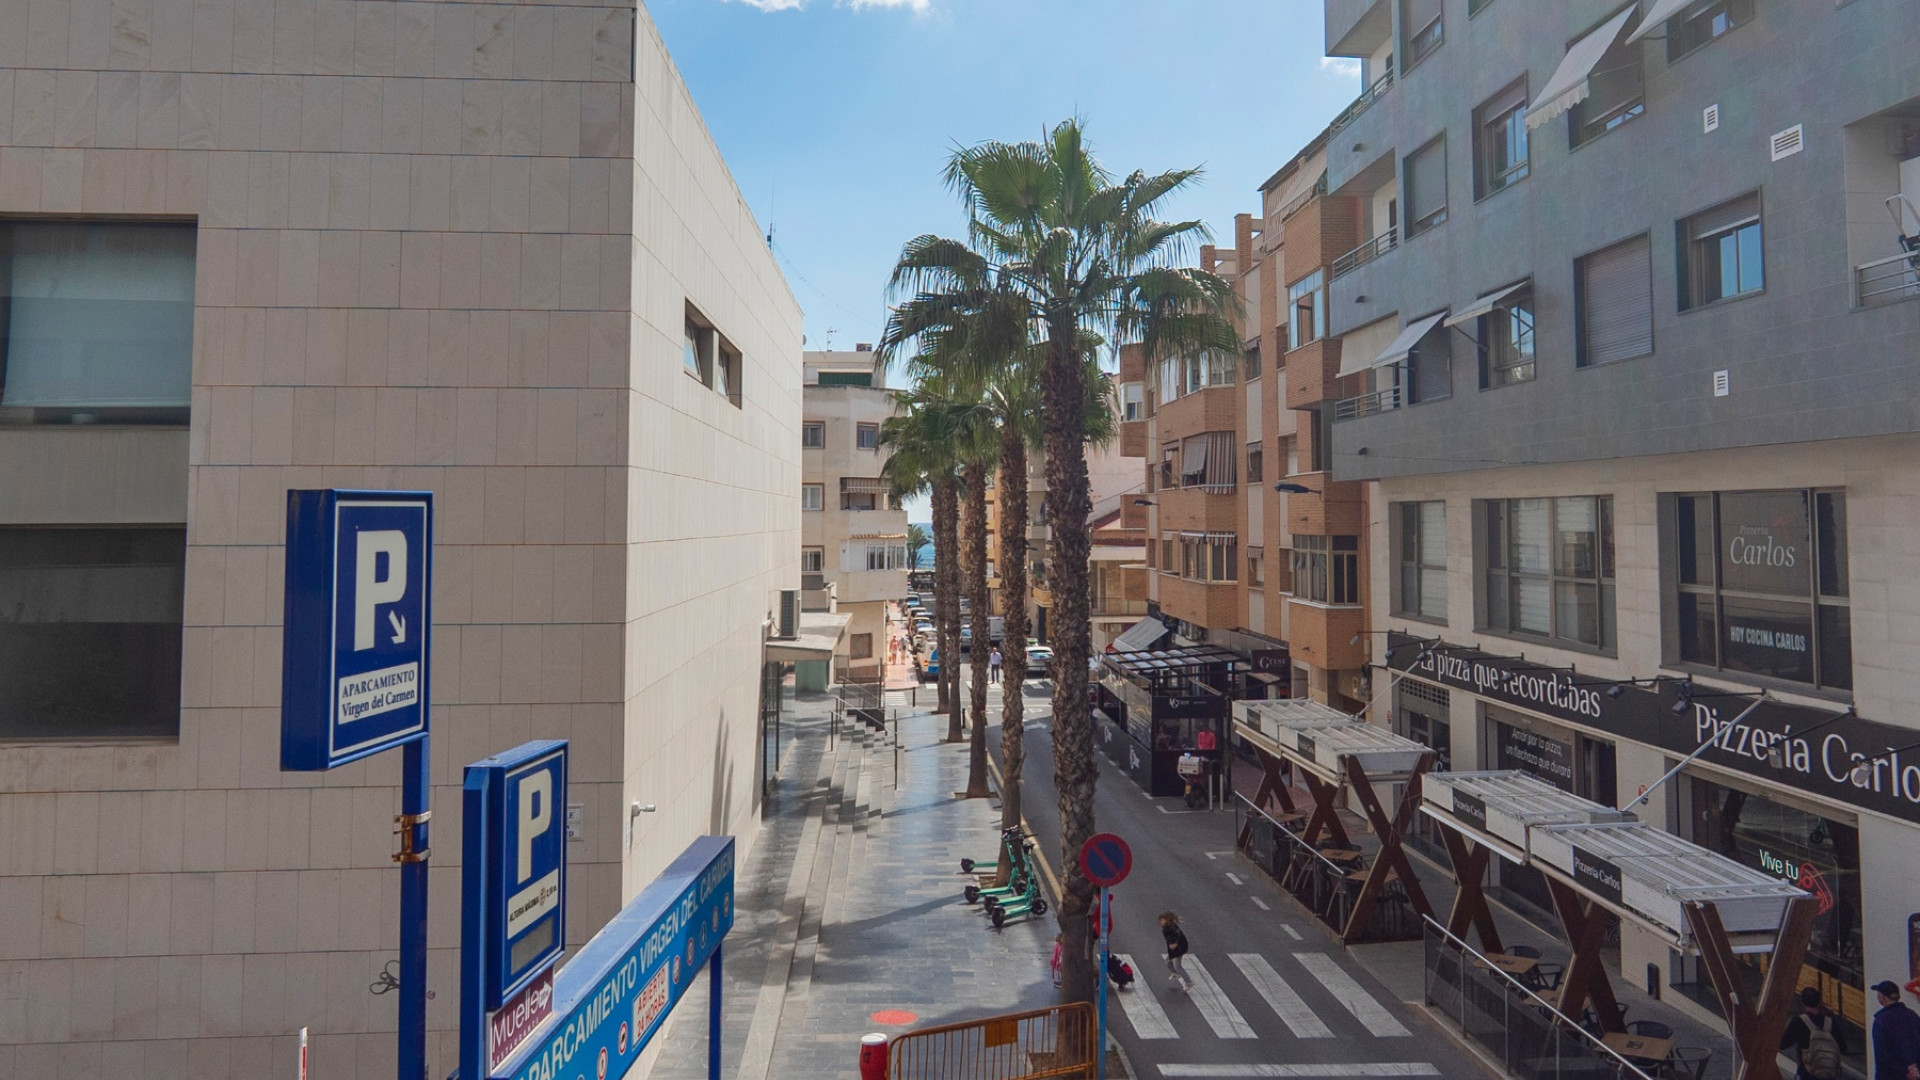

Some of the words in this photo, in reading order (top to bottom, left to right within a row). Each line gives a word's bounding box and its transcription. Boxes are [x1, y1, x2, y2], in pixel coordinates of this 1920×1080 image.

[1730, 536, 1795, 567] Carlos
[354, 530, 407, 651] P
[1730, 625, 1745, 643] HOY
[1746, 628, 1774, 648] COCINA
[1775, 632, 1806, 652] CARLOS
[342, 670, 415, 698] APARCAMIENTO
[1436, 650, 1470, 681] pizza
[1474, 663, 1499, 693] que
[342, 701, 369, 718] Virgen
[371, 694, 384, 709] del
[386, 690, 415, 705] Carmen
[1693, 702, 1810, 774] Pizzería
[517, 768, 552, 885] P
[1599, 870, 1620, 891] Carlos
[1759, 849, 1783, 874] Vive
[1785, 860, 1799, 880] tu
[516, 956, 637, 1080] PARCAMIENTO
[640, 907, 679, 974] VIRGEN
[681, 889, 698, 927] DEL
[638, 969, 665, 1014] ABIERTO
[492, 987, 539, 1053] Muelle
